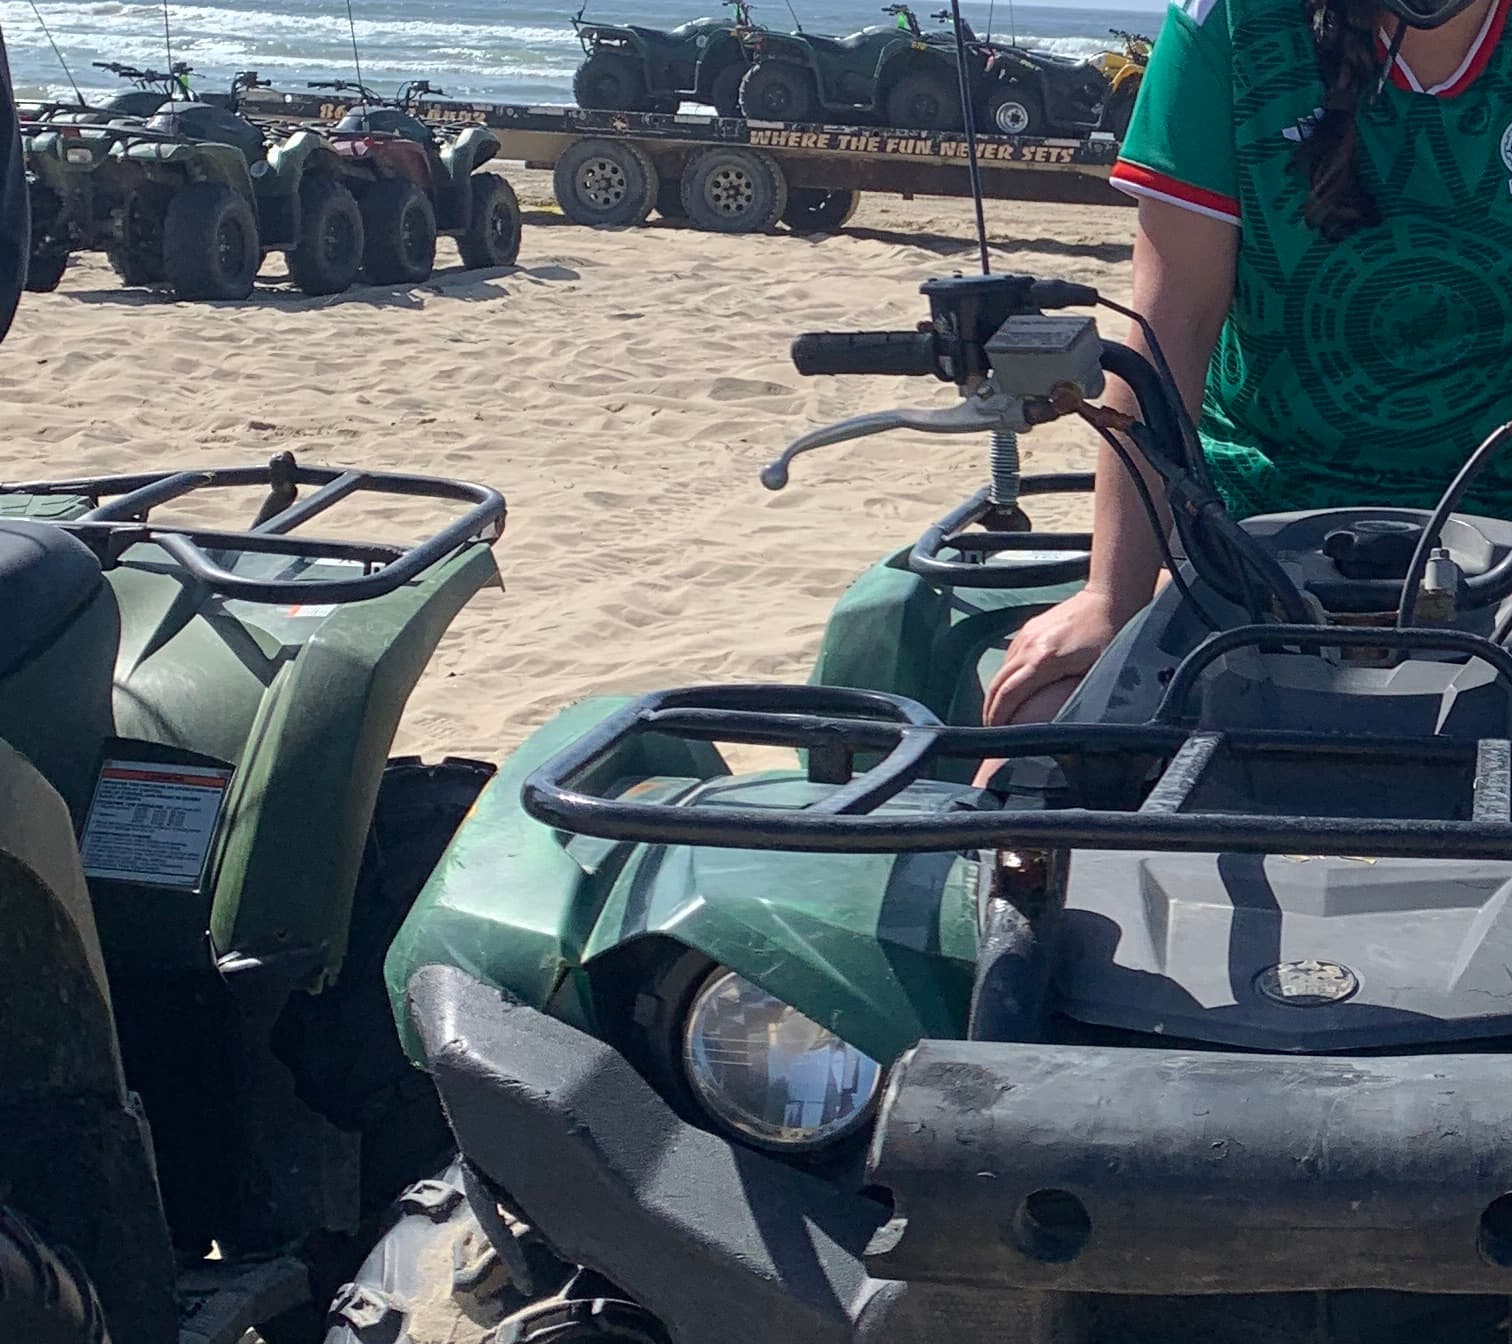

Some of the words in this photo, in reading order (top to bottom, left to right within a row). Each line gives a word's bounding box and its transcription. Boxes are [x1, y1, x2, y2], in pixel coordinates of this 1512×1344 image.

[750, 130, 830, 149] WHERE
[838, 135, 881, 153] THE
[886, 138, 932, 155] FUN
[939, 141, 1014, 160] NEVER
[1021, 145, 1075, 163] SETS
